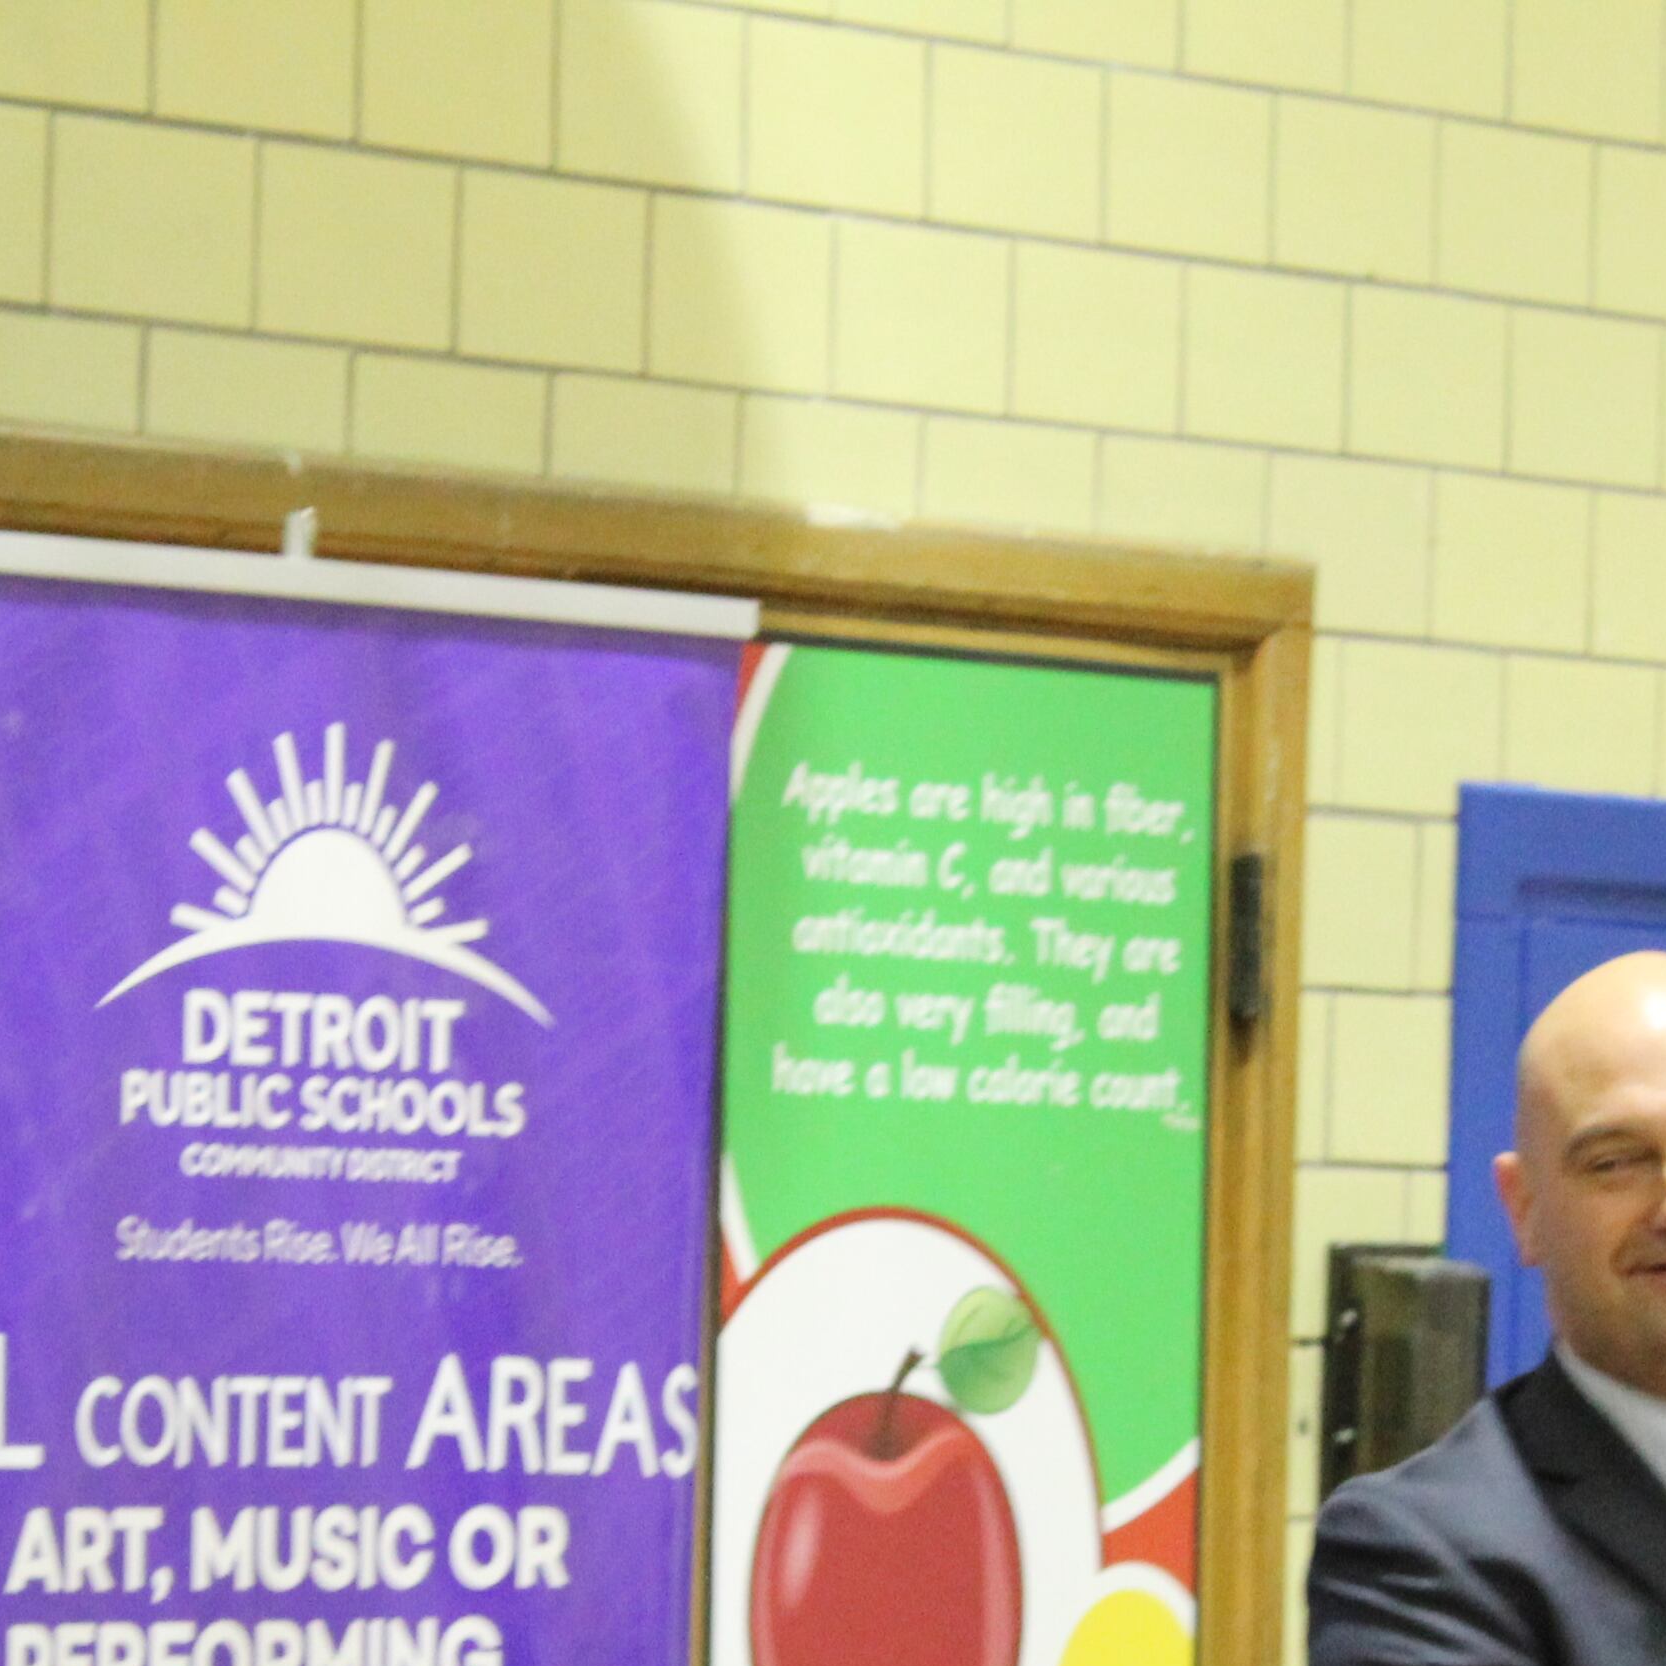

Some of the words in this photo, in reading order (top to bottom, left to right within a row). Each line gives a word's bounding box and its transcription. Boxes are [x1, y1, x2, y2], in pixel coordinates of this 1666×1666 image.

[781, 761, 900, 826] Apples
[908, 782, 971, 822] are
[980, 770, 1053, 841] high
[1063, 779, 1096, 831] in
[1104, 781, 1195, 845] fiber,
[801, 834, 929, 889] vitamin
[938, 840, 976, 900] C,
[988, 845, 1055, 898] and
[1060, 853, 1179, 907] various
[792, 905, 1017, 966] antioxidants.
[1030, 916, 1116, 985] They
[1122, 936, 1183, 975] are
[182, 987, 467, 1074] DETROIT
[812, 972, 886, 1028] also
[894, 993, 976, 1048] very
[984, 981, 1085, 1053] filling,
[1096, 991, 1163, 1042] and
[119, 1067, 293, 1131] PUBLIC
[299, 1075, 527, 1139] SCHOOLS
[771, 1040, 855, 1098] have
[863, 1061, 892, 1099] a
[900, 1046, 959, 1102] low
[966, 1052, 1083, 1108] calorie
[179, 1141, 348, 1180] COMMUNITY
[344, 1147, 464, 1184] DISTRICT
[116, 1214, 261, 1262] Students
[263, 1218, 339, 1265] Rise.
[339, 1220, 395, 1267] We
[394, 1222, 439, 1267] All
[441, 1222, 525, 1268] Rise.
[73, 1373, 395, 1471] CONTENT
[404, 1351, 701, 1481] AREAS
[3, 1505, 175, 1605] ART,
[189, 1503, 437, 1594] MUSIC
[448, 1503, 572, 1592] OR
